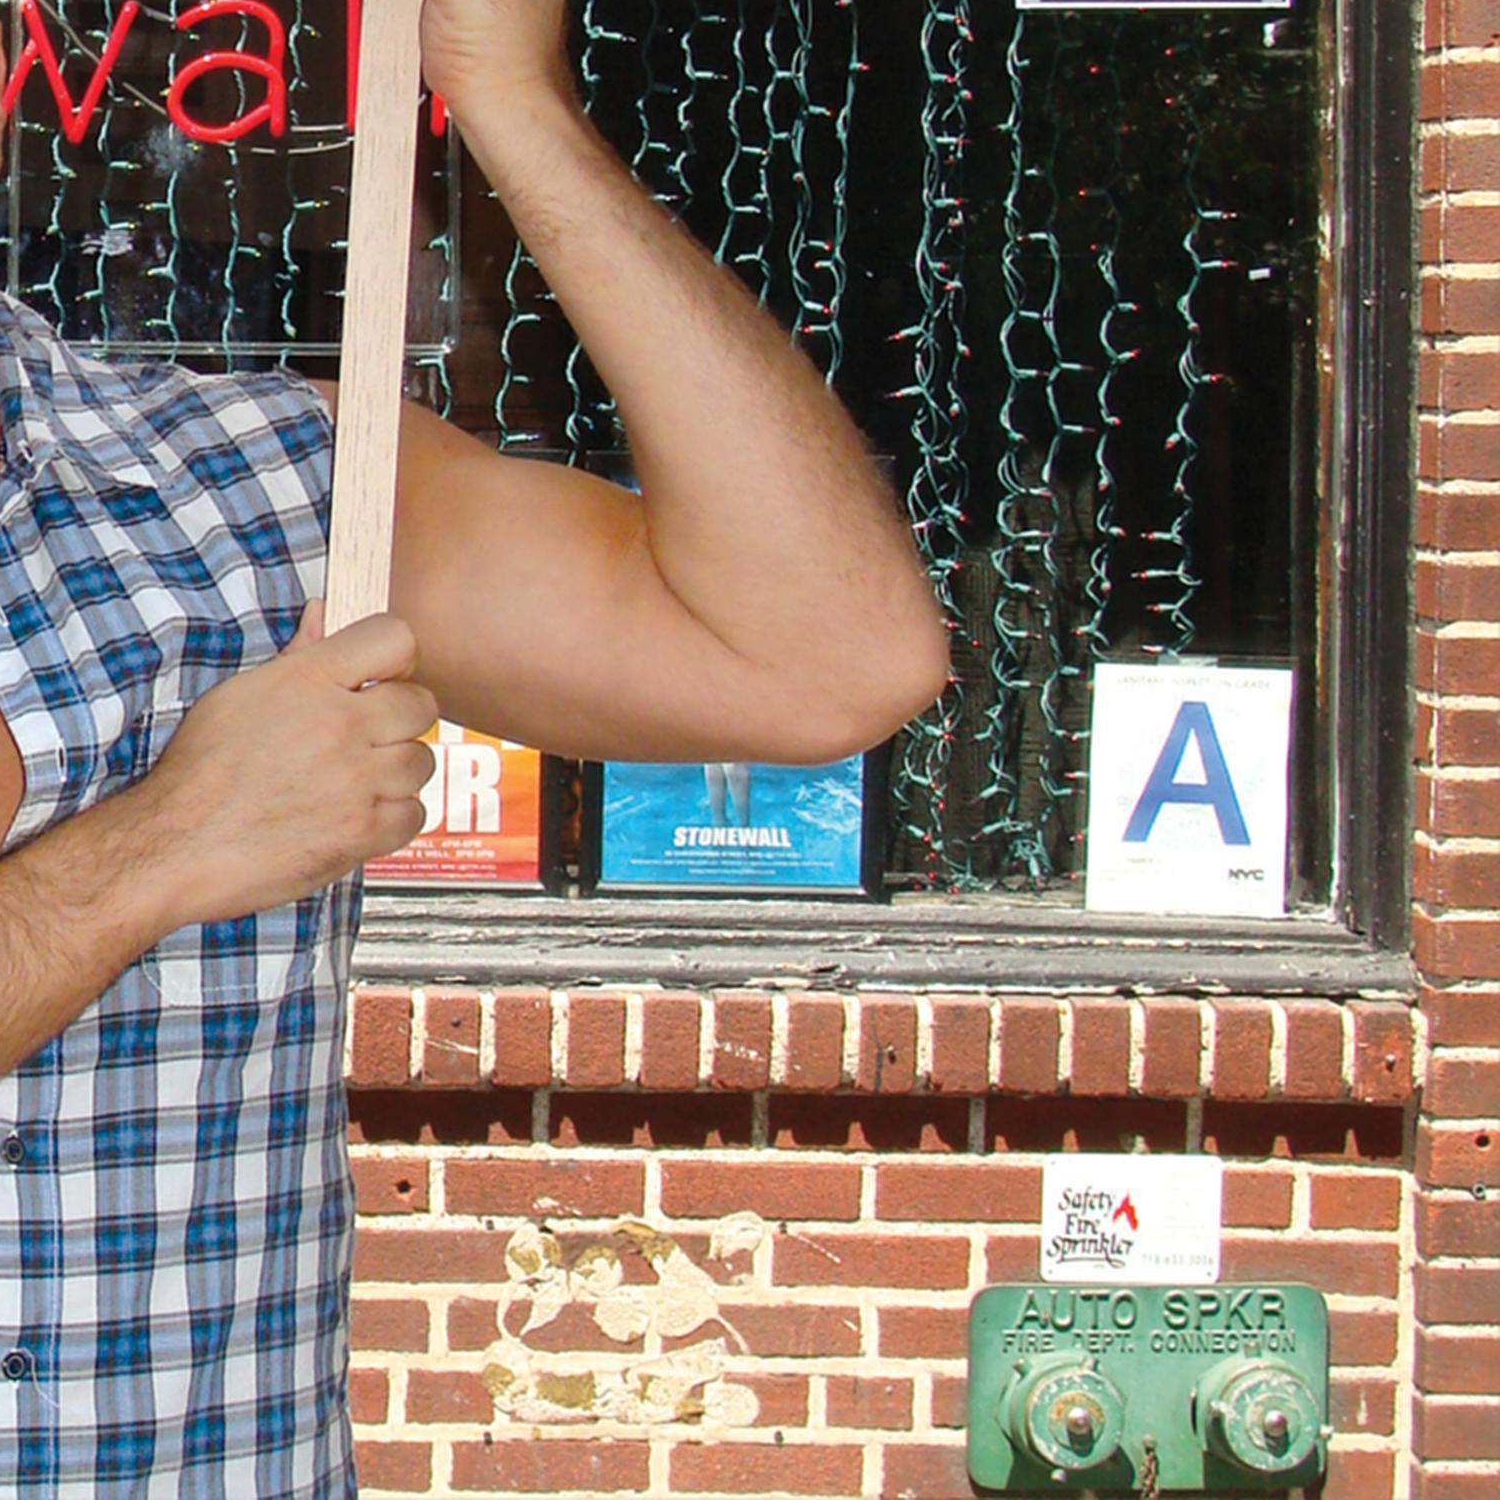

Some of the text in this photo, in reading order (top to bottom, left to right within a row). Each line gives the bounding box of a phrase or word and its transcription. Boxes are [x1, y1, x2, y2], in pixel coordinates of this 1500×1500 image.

[1122, 701, 1251, 846] A
[673, 826, 792, 848] STONEWALL
[1228, 868, 1265, 881] NYC
[1058, 1186, 1113, 1218] Safety
[1065, 1213, 1101, 1235] Fire
[1046, 1232, 1134, 1267] Sprinkler
[1016, 1289, 1287, 1332] AUTO SPKR
[1002, 1330, 1054, 1353] FIRE
[1150, 1330, 1296, 1354] CONNECTION
